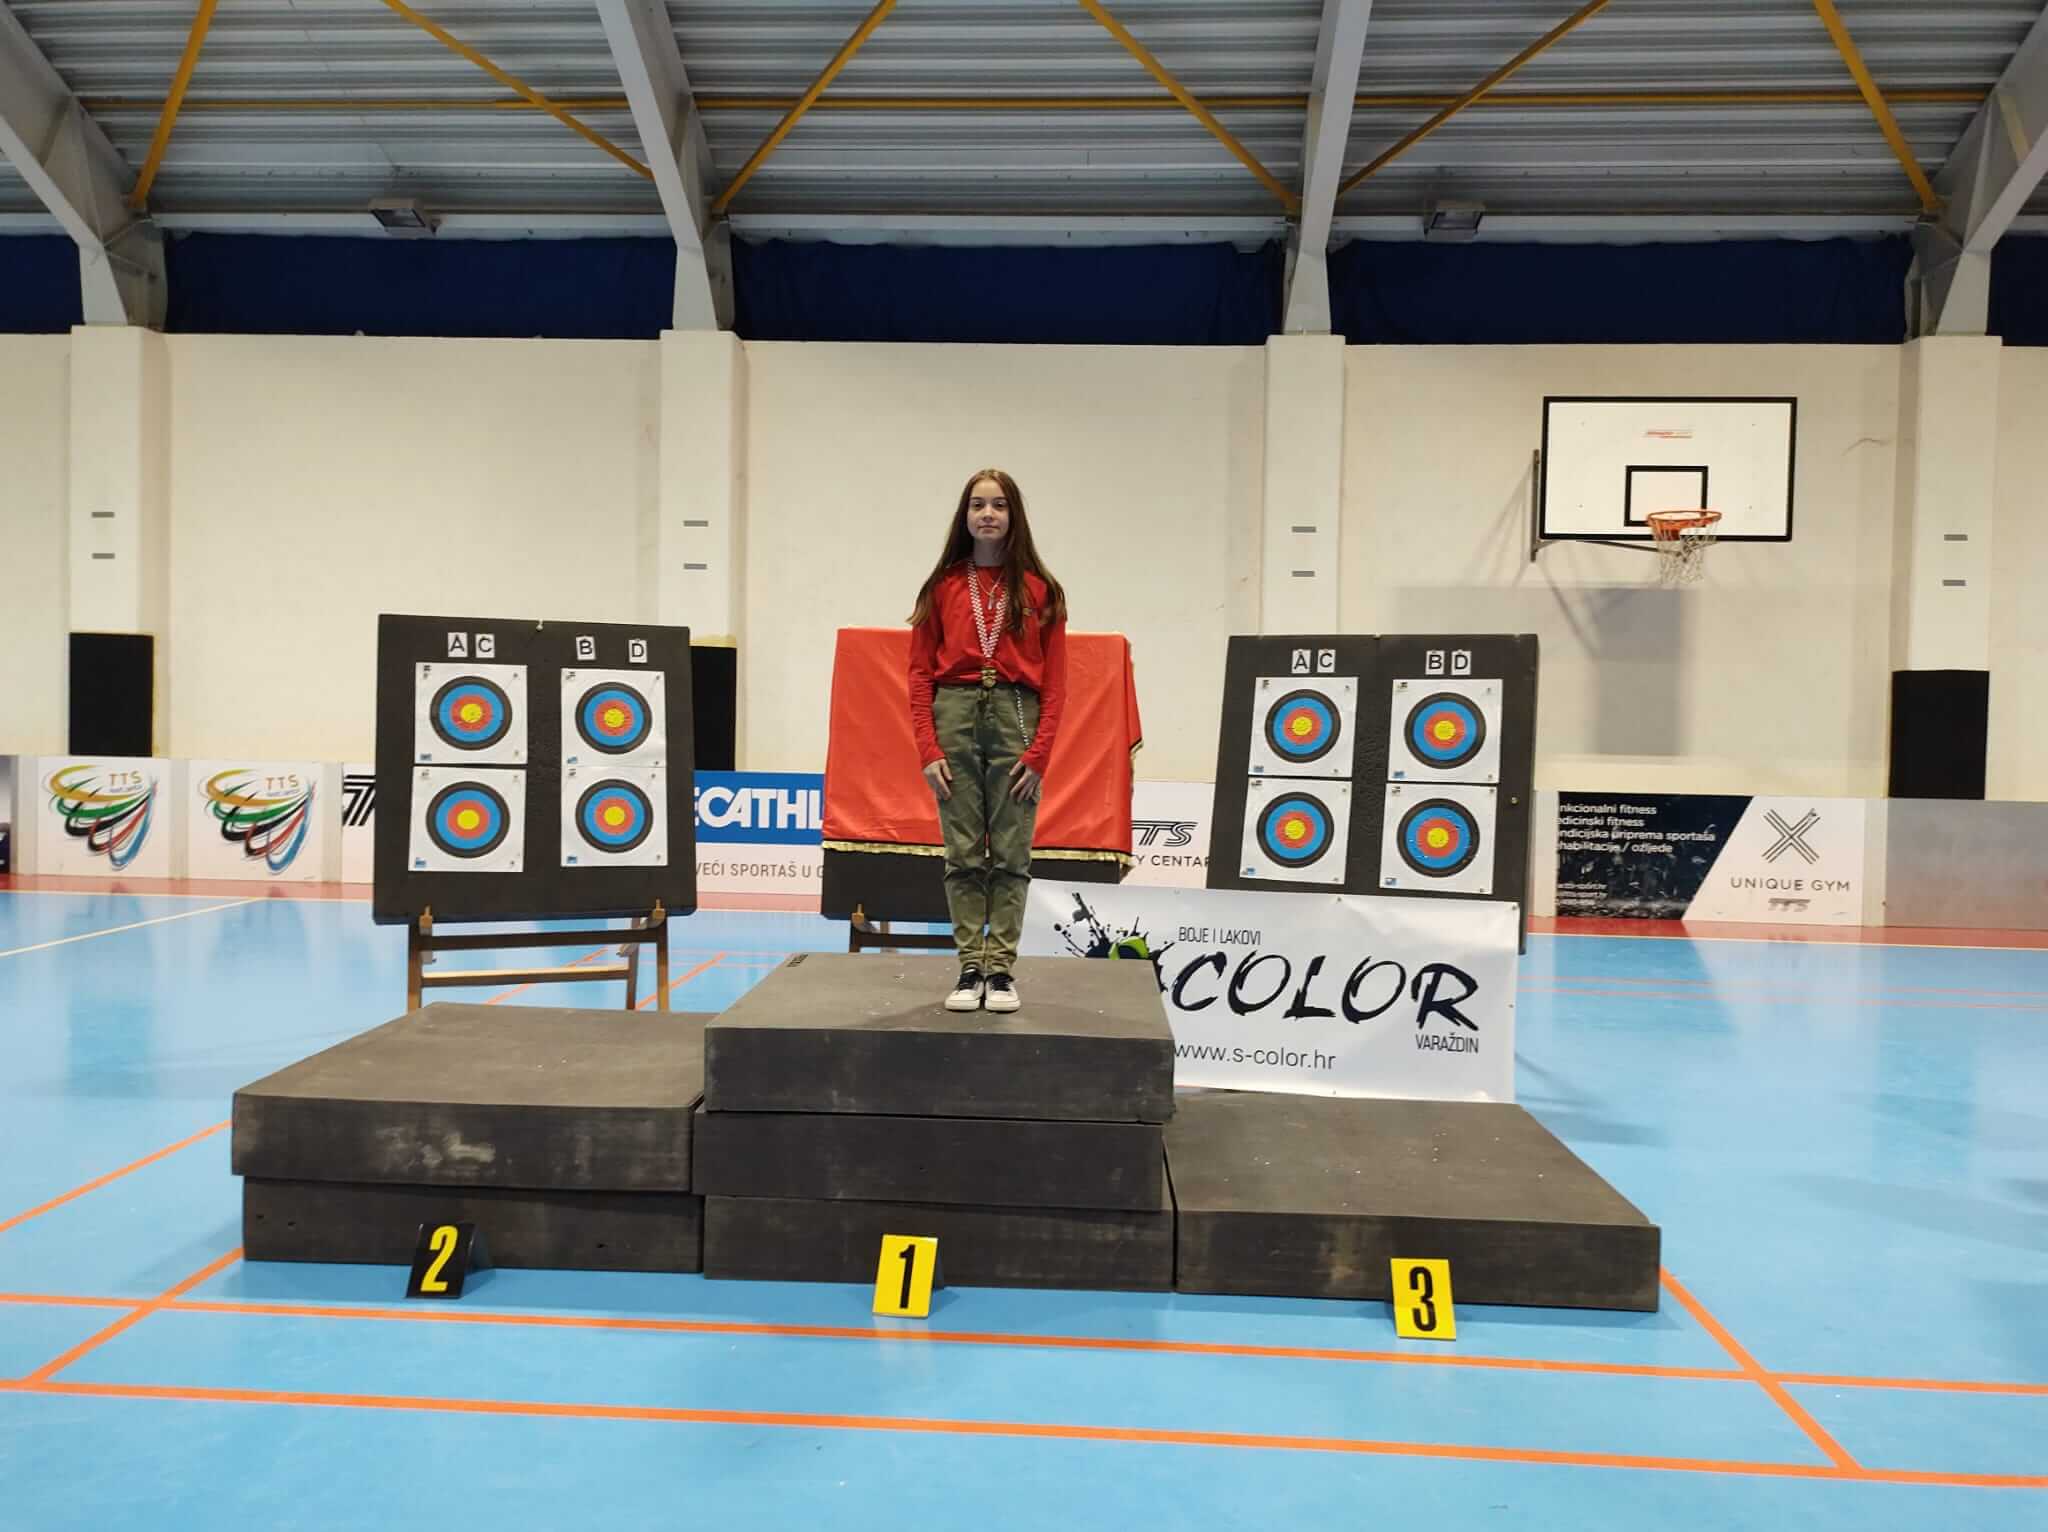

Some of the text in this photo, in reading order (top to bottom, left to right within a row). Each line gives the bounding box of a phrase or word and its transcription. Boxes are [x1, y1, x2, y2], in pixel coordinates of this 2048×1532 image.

[450, 635, 493, 653] A C
[578, 639, 645, 658] B D
[1294, 651, 1334, 670] A C
[1428, 653, 1469, 670] B D
[108, 770, 142, 787] TTS
[265, 774, 298, 790] TTS
[1619, 804, 1657, 815] fitness
[1607, 816, 1645, 827] fitness
[730, 861, 797, 878] SPORTAŠ
[1730, 877, 1851, 892] UNIQUE GYM
[1178, 926, 1209, 943] BOJE
[1219, 928, 1262, 945] LAKOVI
[1415, 1032, 1480, 1054] VARAŽDIN
[1174, 1044, 1337, 1070] www.s-color.hr
[420, 1225, 459, 1293] 2
[898, 1243, 917, 1310] 1
[1408, 1266, 1437, 1332] 3
